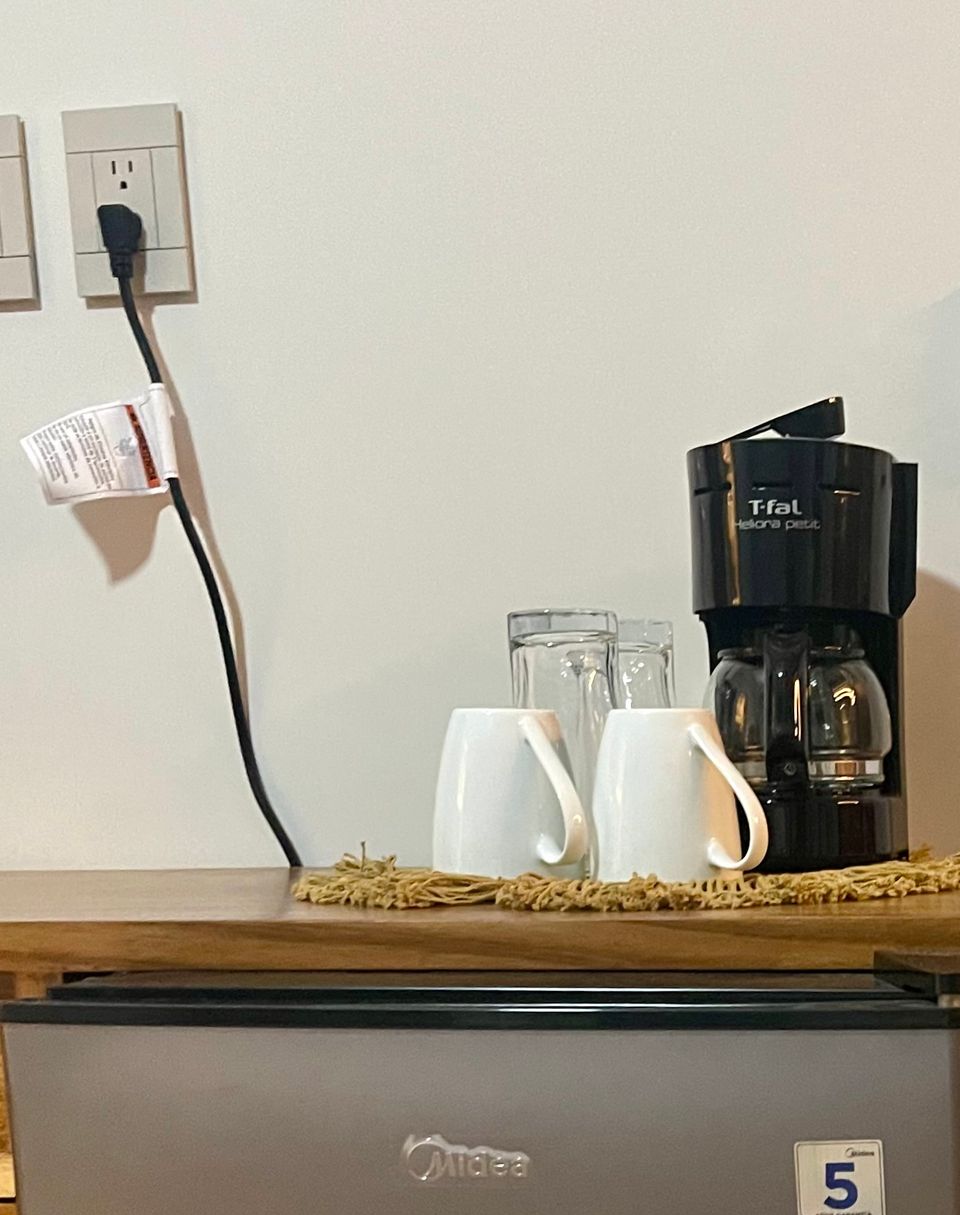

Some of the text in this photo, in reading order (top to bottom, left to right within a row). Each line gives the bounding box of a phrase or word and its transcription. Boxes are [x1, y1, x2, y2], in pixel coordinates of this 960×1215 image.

[748, 499, 802, 515] T-fal
[404, 1136, 530, 1181] Midea
[824, 1162, 858, 1209] 5
